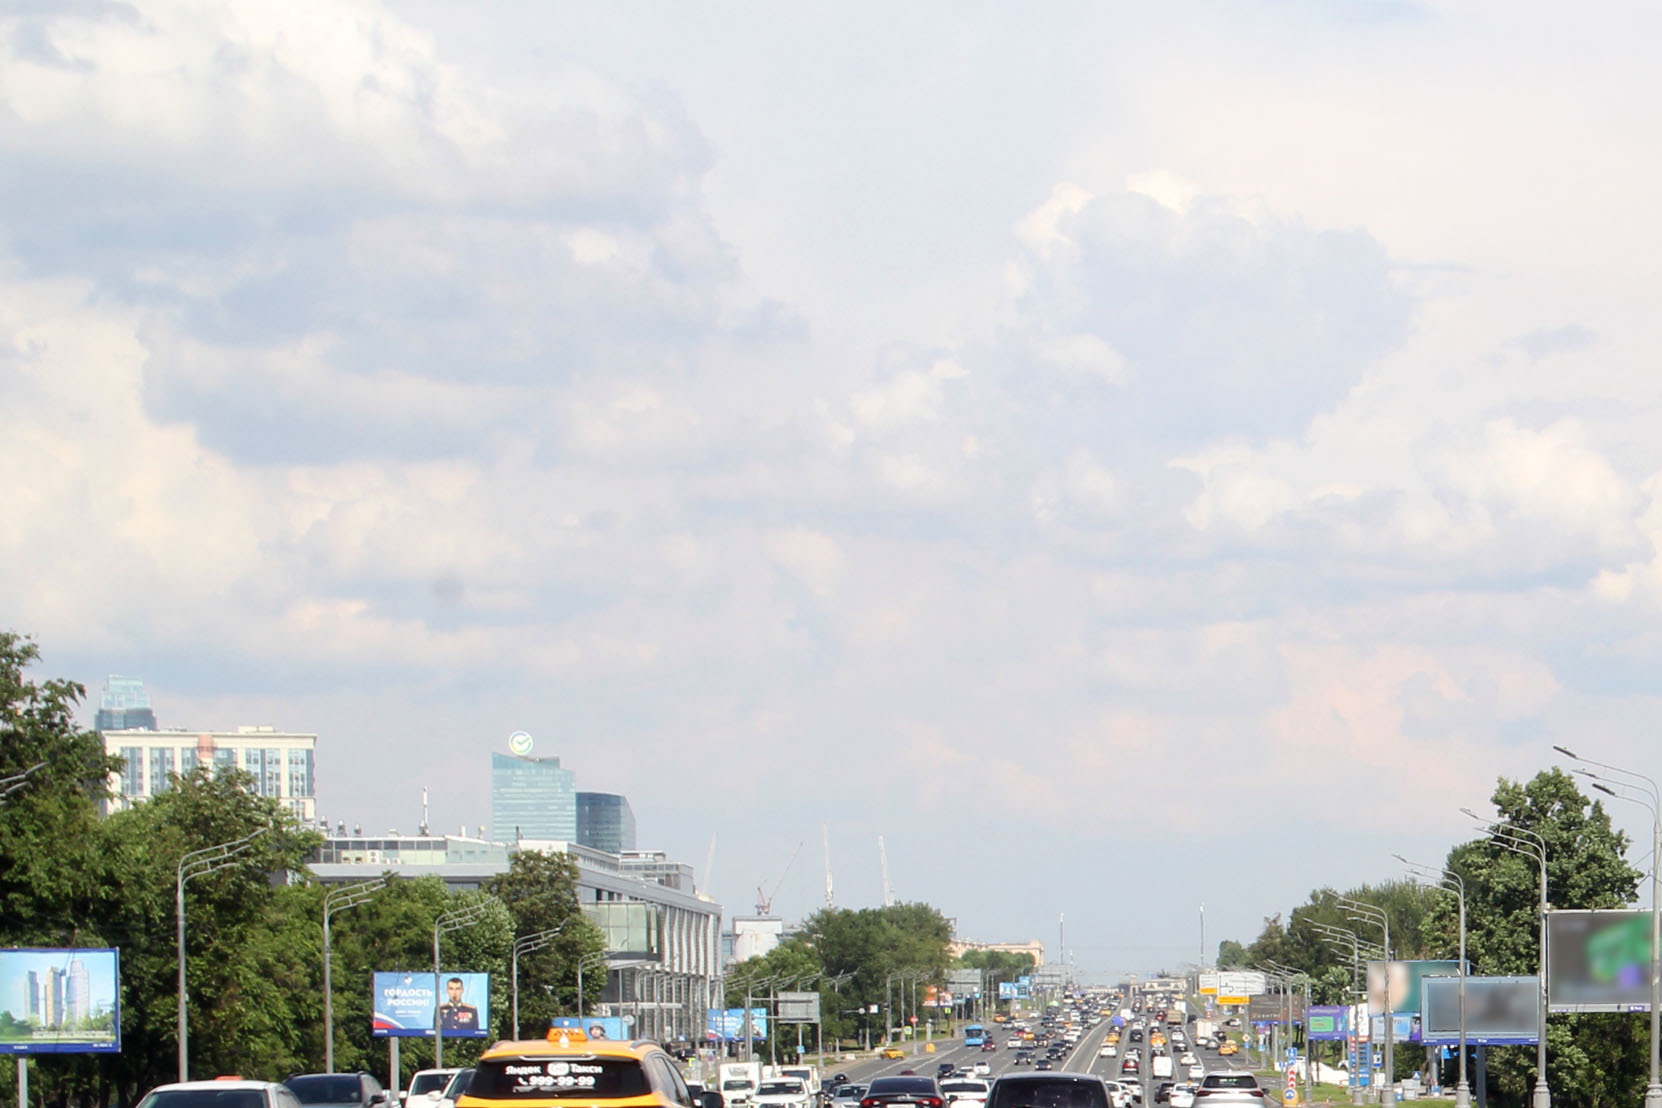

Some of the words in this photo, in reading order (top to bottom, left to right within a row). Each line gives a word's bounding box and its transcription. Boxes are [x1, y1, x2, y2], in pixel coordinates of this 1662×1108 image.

[383, 988, 433, 998] ГОРДОСТЬ
[570, 1063, 604, 1074] Такси
[528, 1075, 596, 1086] 999-99-99
